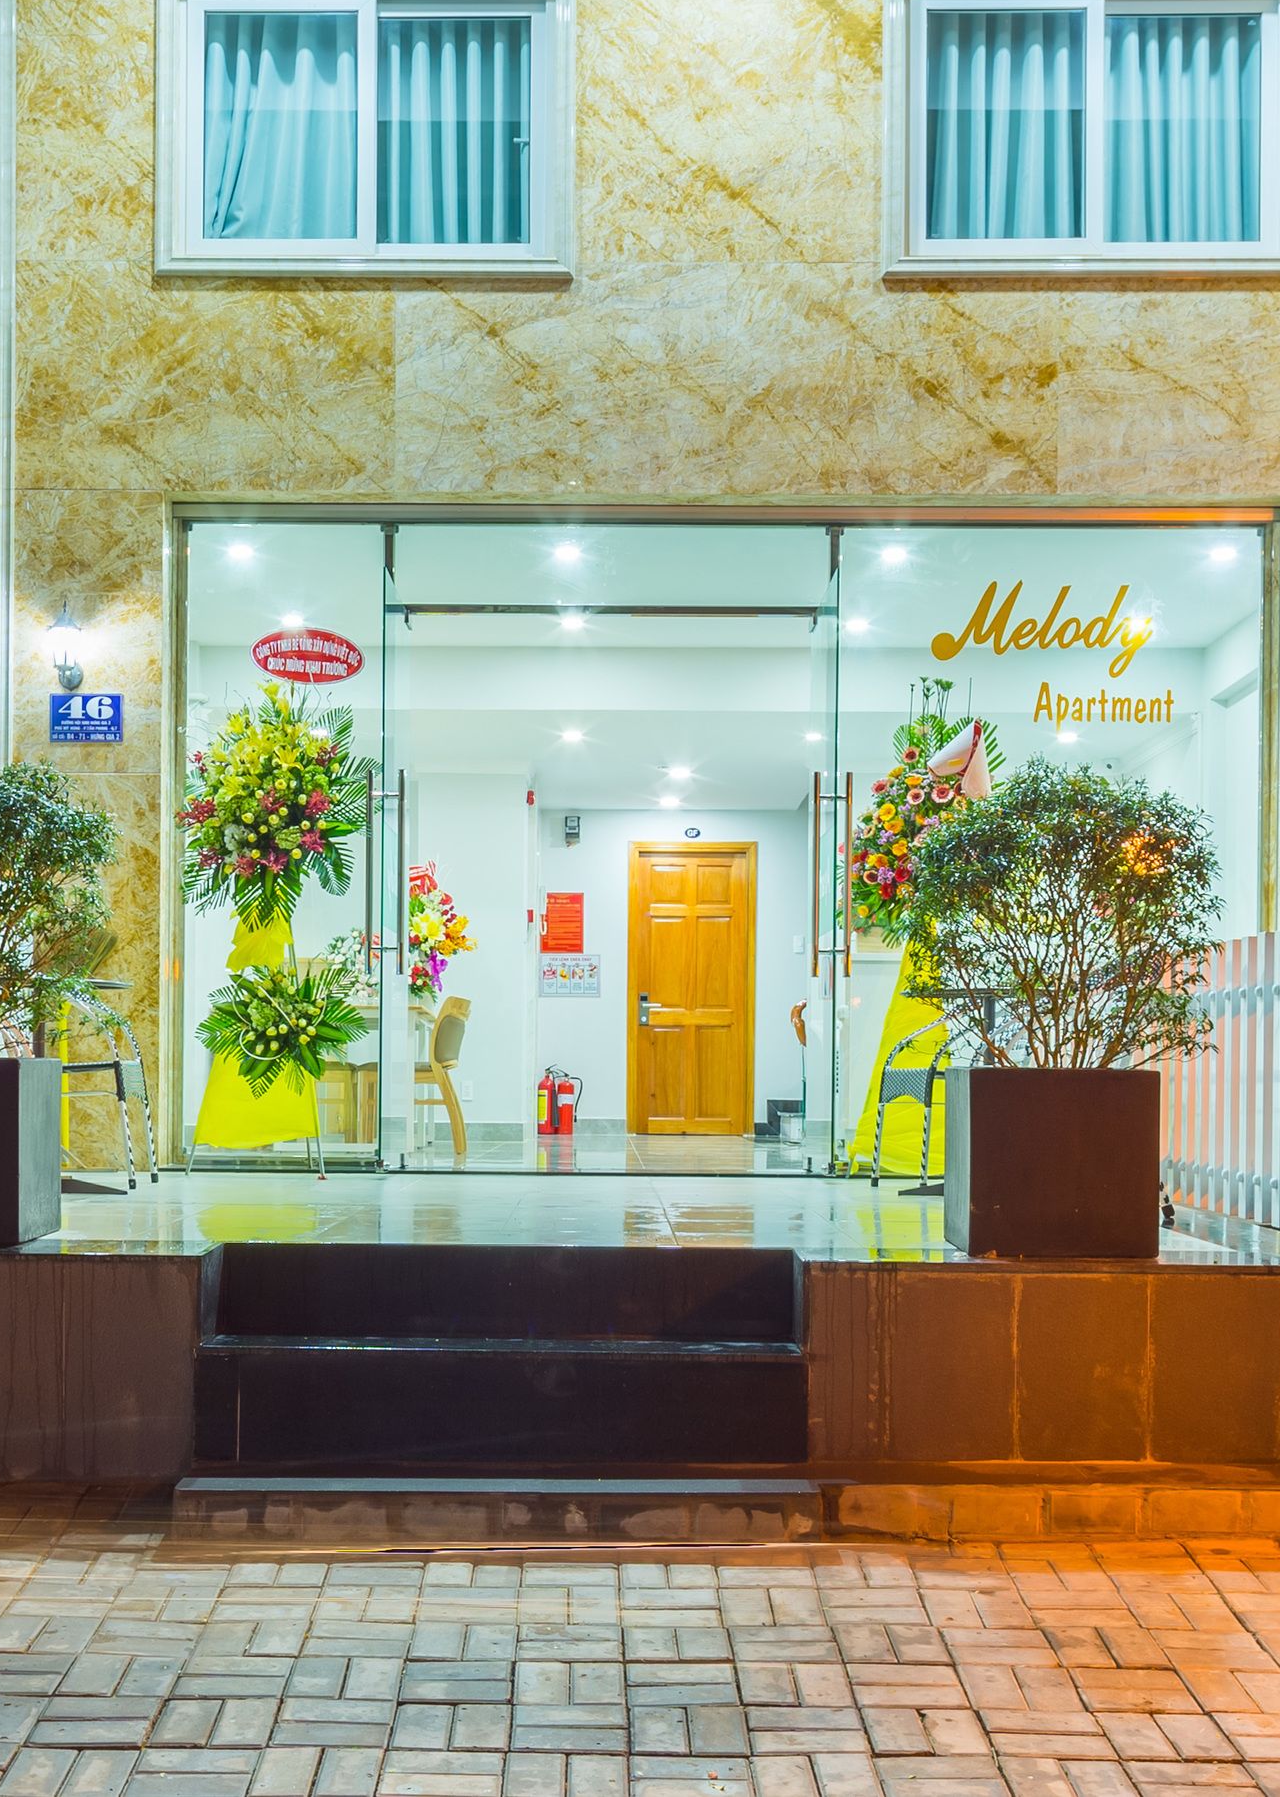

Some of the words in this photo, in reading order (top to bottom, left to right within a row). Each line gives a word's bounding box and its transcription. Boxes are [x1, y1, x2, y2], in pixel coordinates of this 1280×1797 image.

[930, 579, 1153, 678] Melody
[58, 696, 114, 720] 46
[1033, 681, 1175, 732] Apartment
